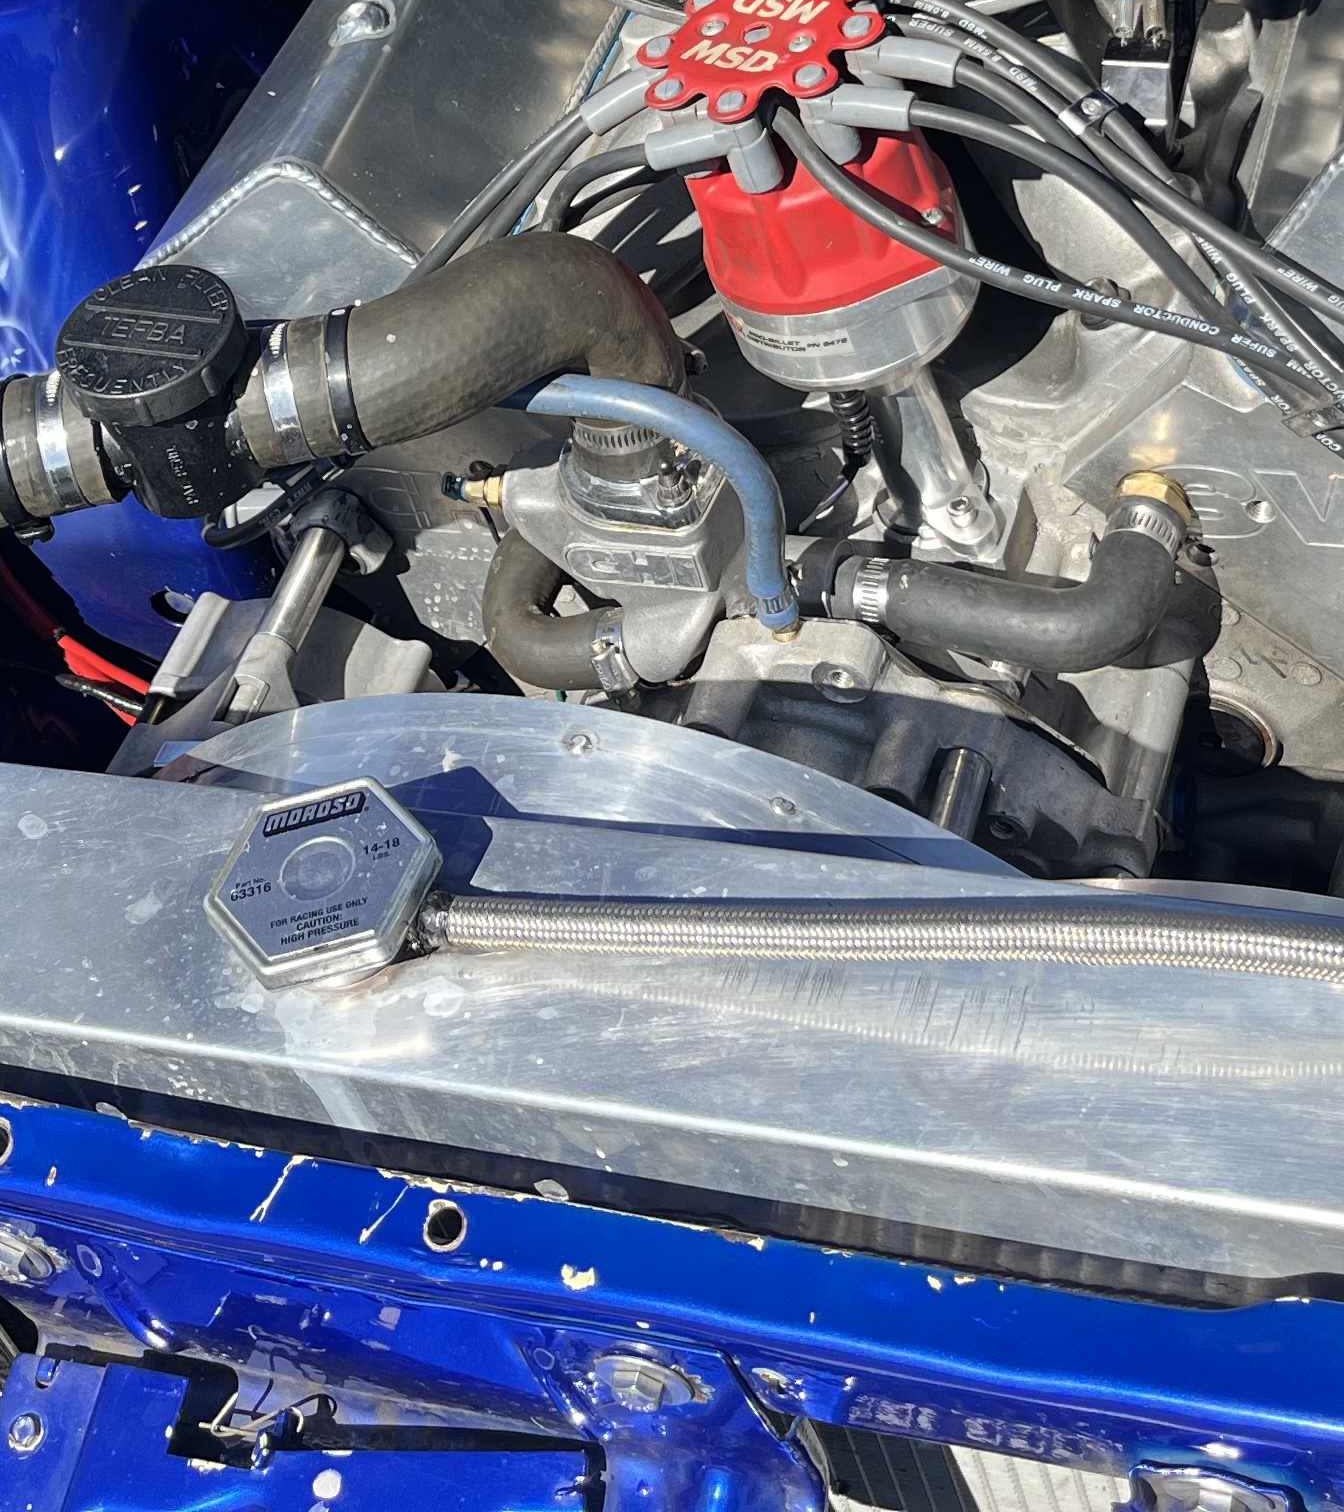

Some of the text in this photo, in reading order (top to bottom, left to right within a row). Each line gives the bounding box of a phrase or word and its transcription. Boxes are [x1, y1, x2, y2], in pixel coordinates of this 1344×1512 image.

[908, 18, 954, 37] SUPER
[680, 39, 778, 72] MSD
[93, 268, 229, 312] CLEAN FILTER
[1022, 276, 1062, 292] PLUG
[1072, 288, 1122, 308] SPARK
[1225, 273, 1256, 305] PLUG
[101, 316, 186, 345] TEFBA
[1133, 303, 1220, 336] CONDUCTOR
[1259, 313, 1299, 352] SPARK
[57, 347, 188, 394] FREQUENTLY
[265, 792, 364, 834] MOROSO
[363, 837, 401, 855] 14-18
[230, 882, 272, 902] 63316
[270, 896, 368, 929] FOR RACING USE ONLY
[280, 918, 360, 945] HIGH PRESSURE
